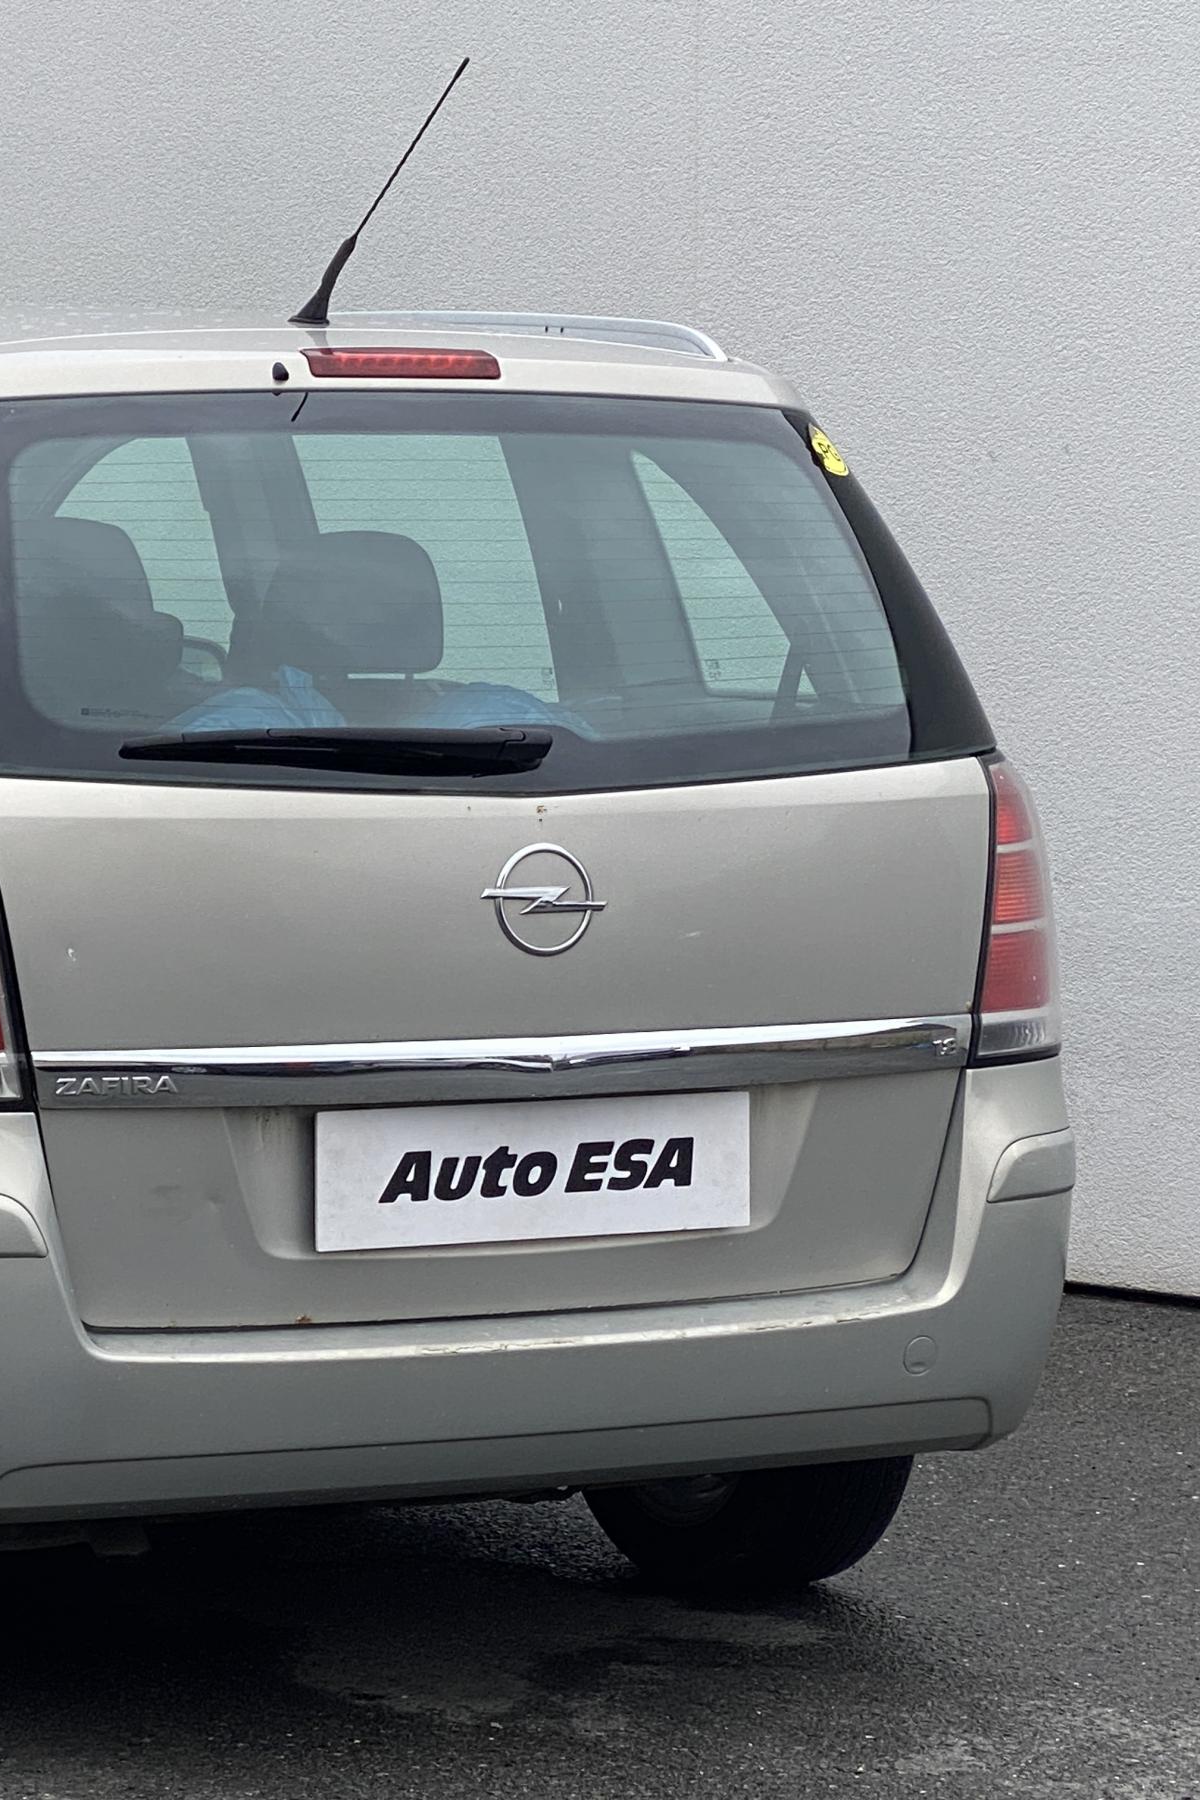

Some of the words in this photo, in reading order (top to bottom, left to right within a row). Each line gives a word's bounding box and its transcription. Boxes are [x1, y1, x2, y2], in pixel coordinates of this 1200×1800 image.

[55, 1075, 179, 1096] ZAFIRA
[377, 1145, 558, 1204] Auto
[564, 1136, 695, 1194] ESA
